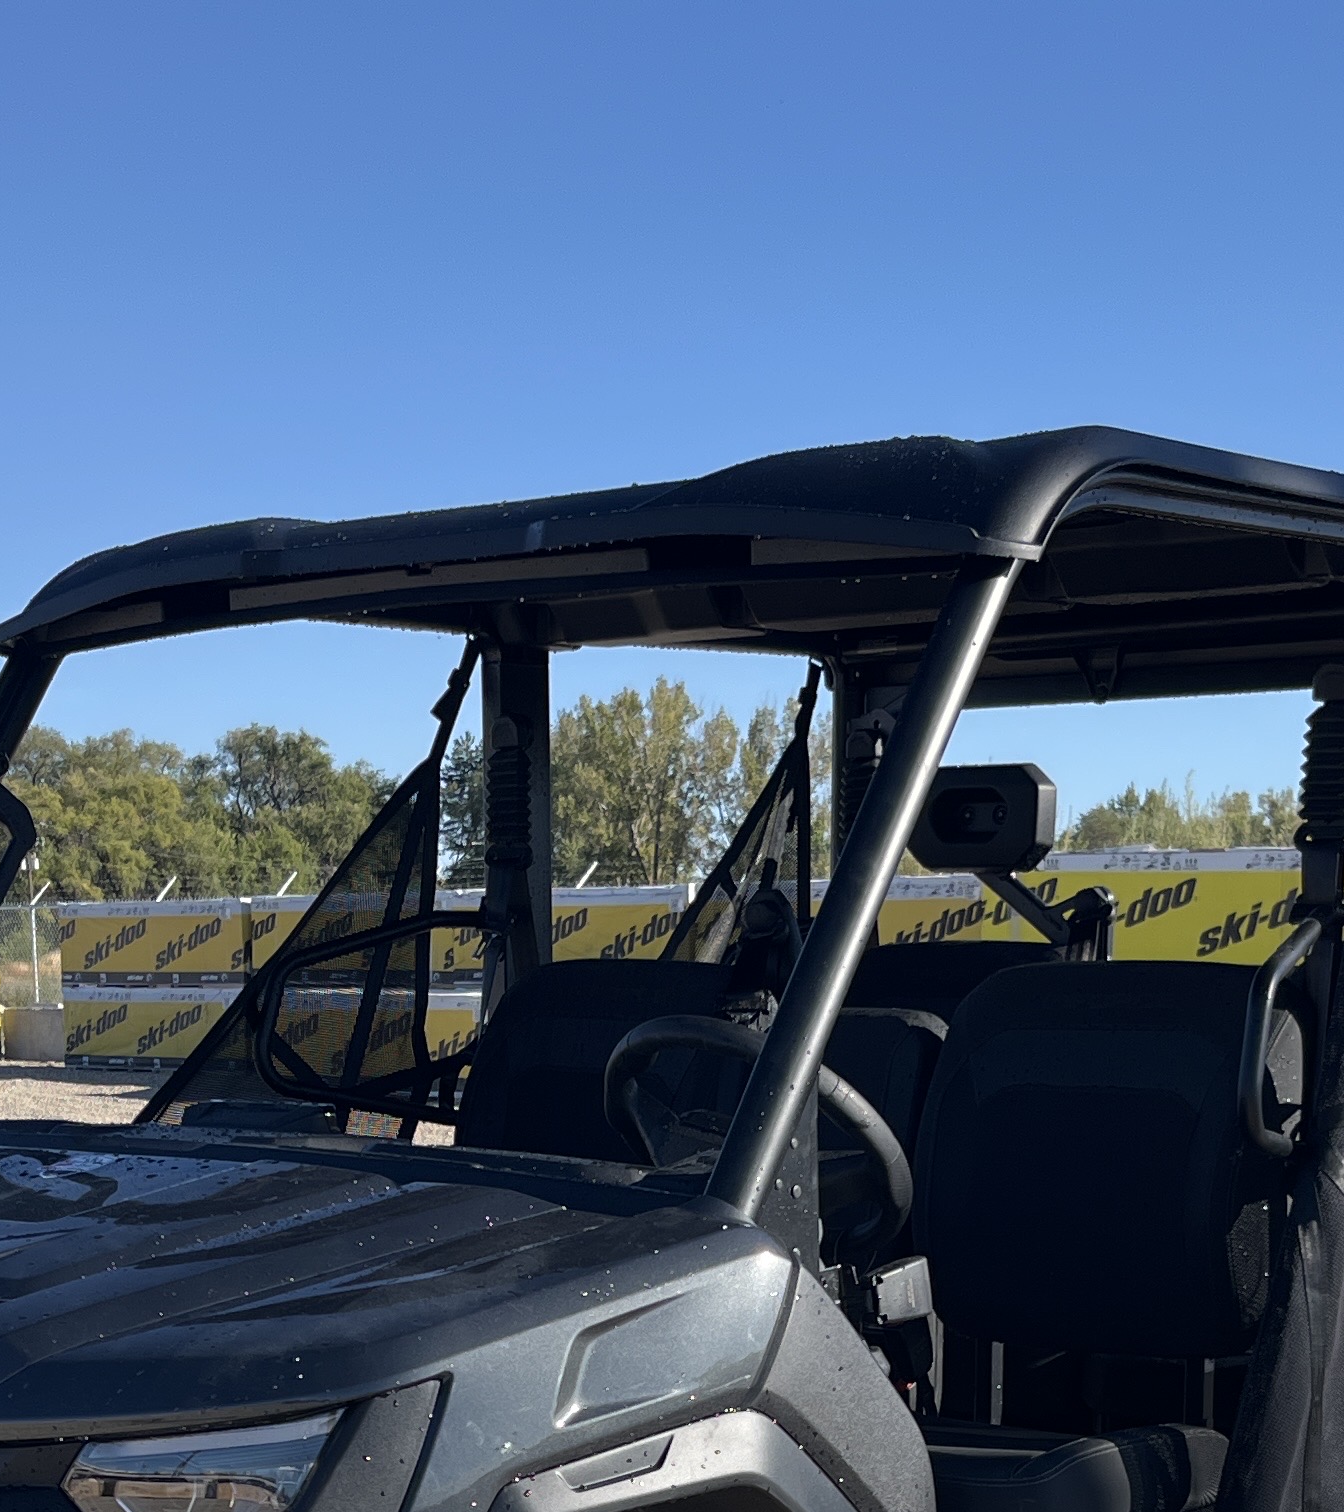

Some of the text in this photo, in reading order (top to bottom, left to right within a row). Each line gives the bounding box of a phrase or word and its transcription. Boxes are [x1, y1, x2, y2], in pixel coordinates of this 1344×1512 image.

[84, 919, 146, 969] ski-doo
[156, 918, 221, 970] ski-doo
[885, 899, 987, 945] ki-doo
[66, 1004, 128, 1053] ski-doo
[137, 1004, 202, 1055] ski-doo
